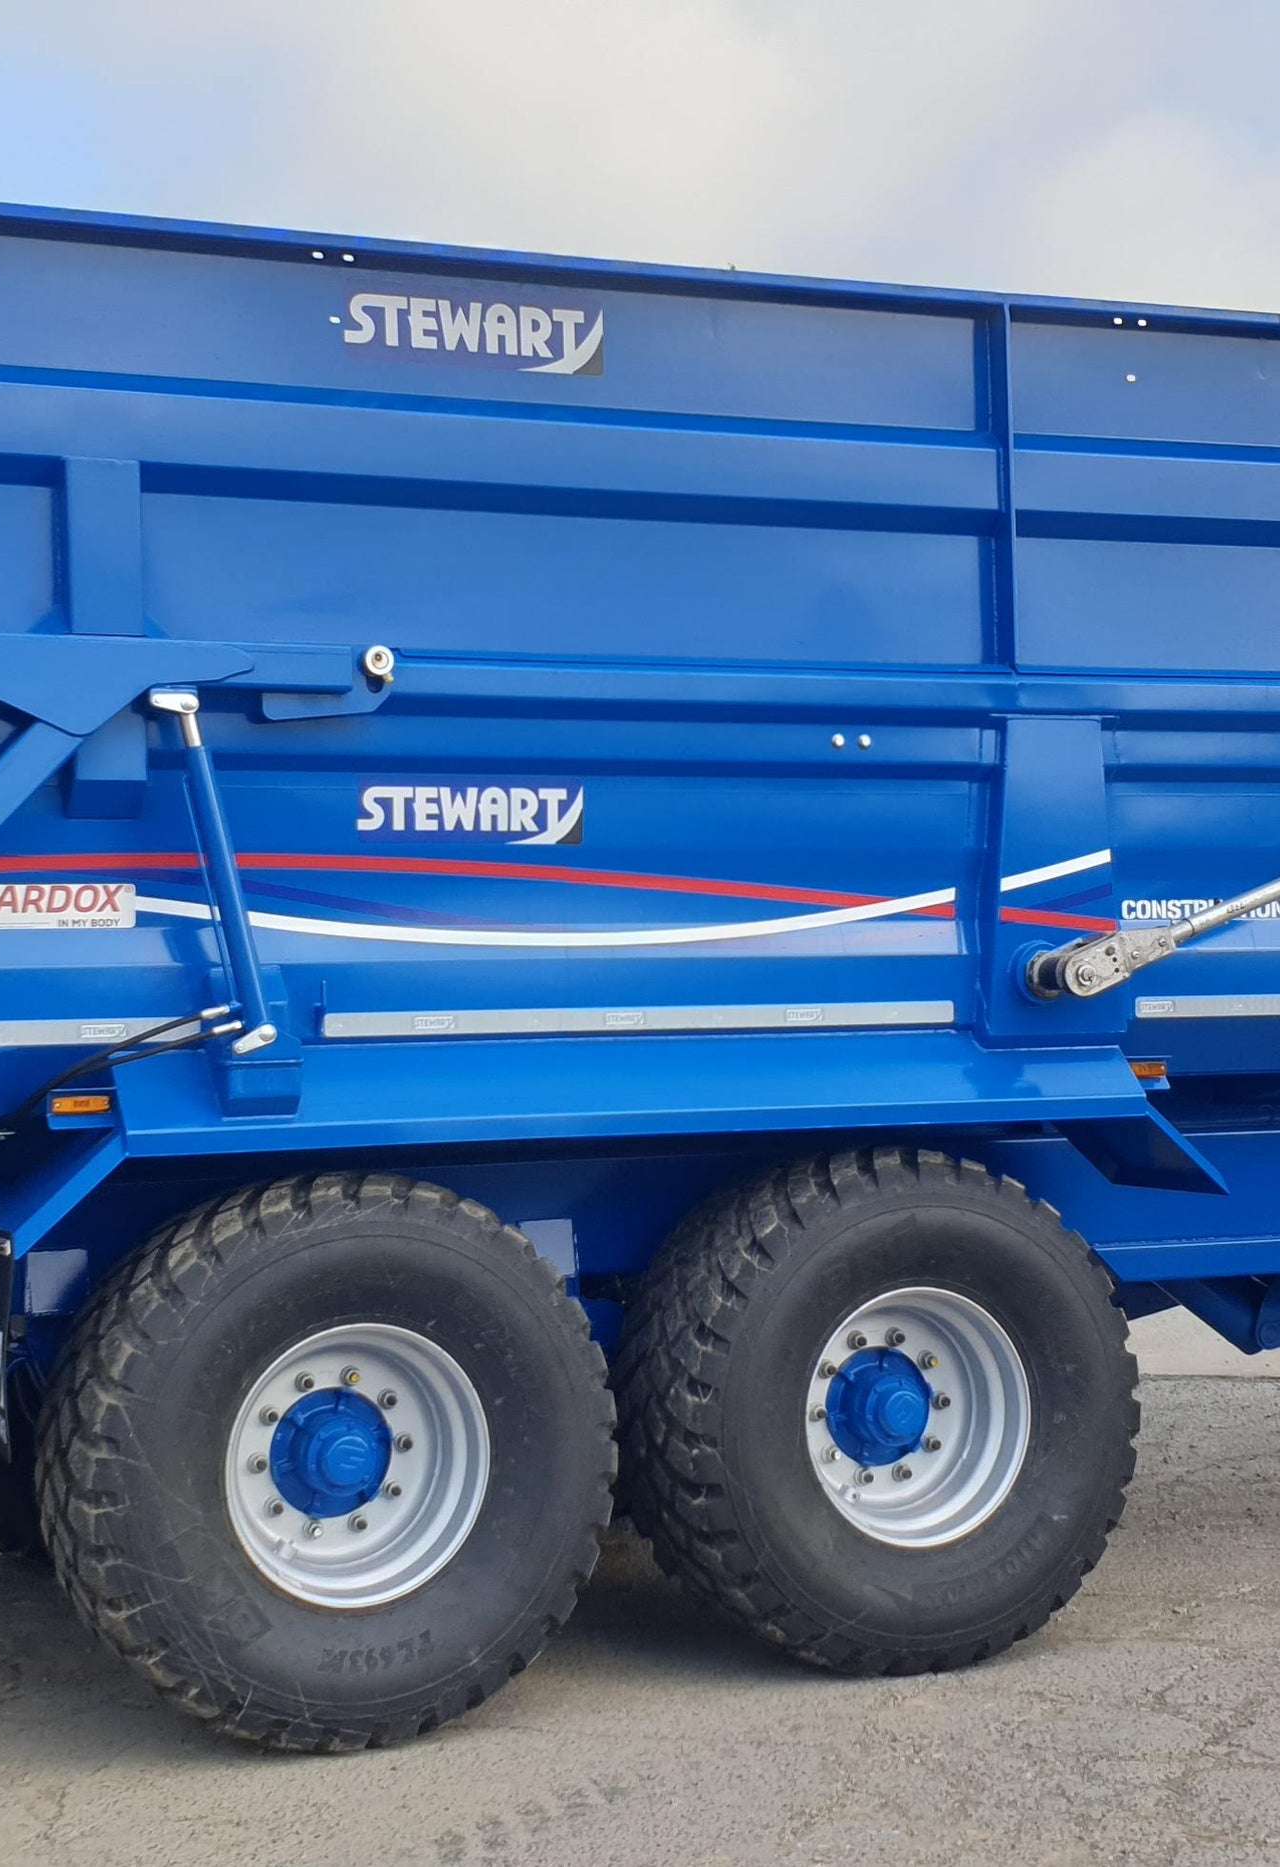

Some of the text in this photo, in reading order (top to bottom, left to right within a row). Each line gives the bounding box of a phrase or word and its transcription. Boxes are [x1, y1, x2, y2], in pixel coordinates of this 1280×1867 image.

[344, 293, 604, 375] STEWART
[357, 786, 584, 844] STEWART
[57, 918, 121, 927] IN MY BODY
